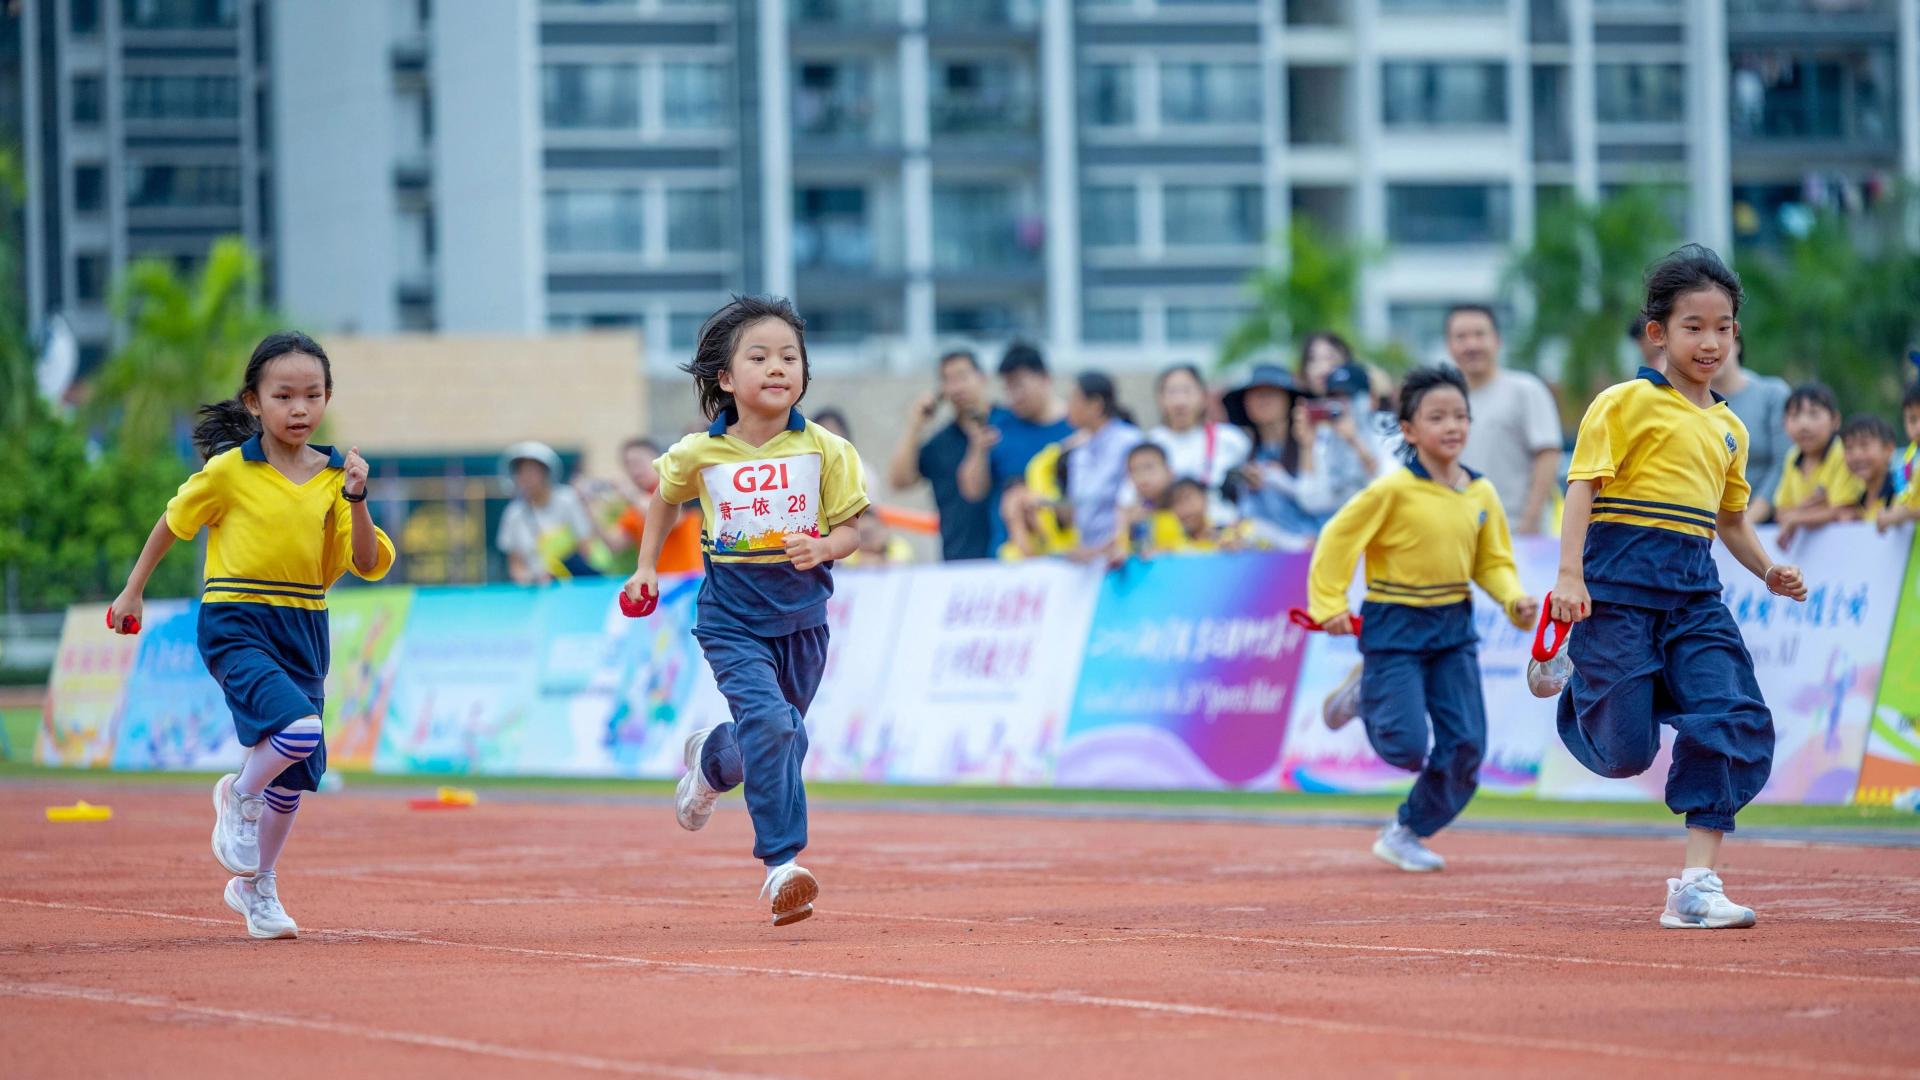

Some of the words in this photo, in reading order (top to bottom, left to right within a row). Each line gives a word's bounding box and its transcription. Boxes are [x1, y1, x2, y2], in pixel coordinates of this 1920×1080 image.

[719, 498, 770, 520] 萧一依
[788, 494, 806, 513] 28
